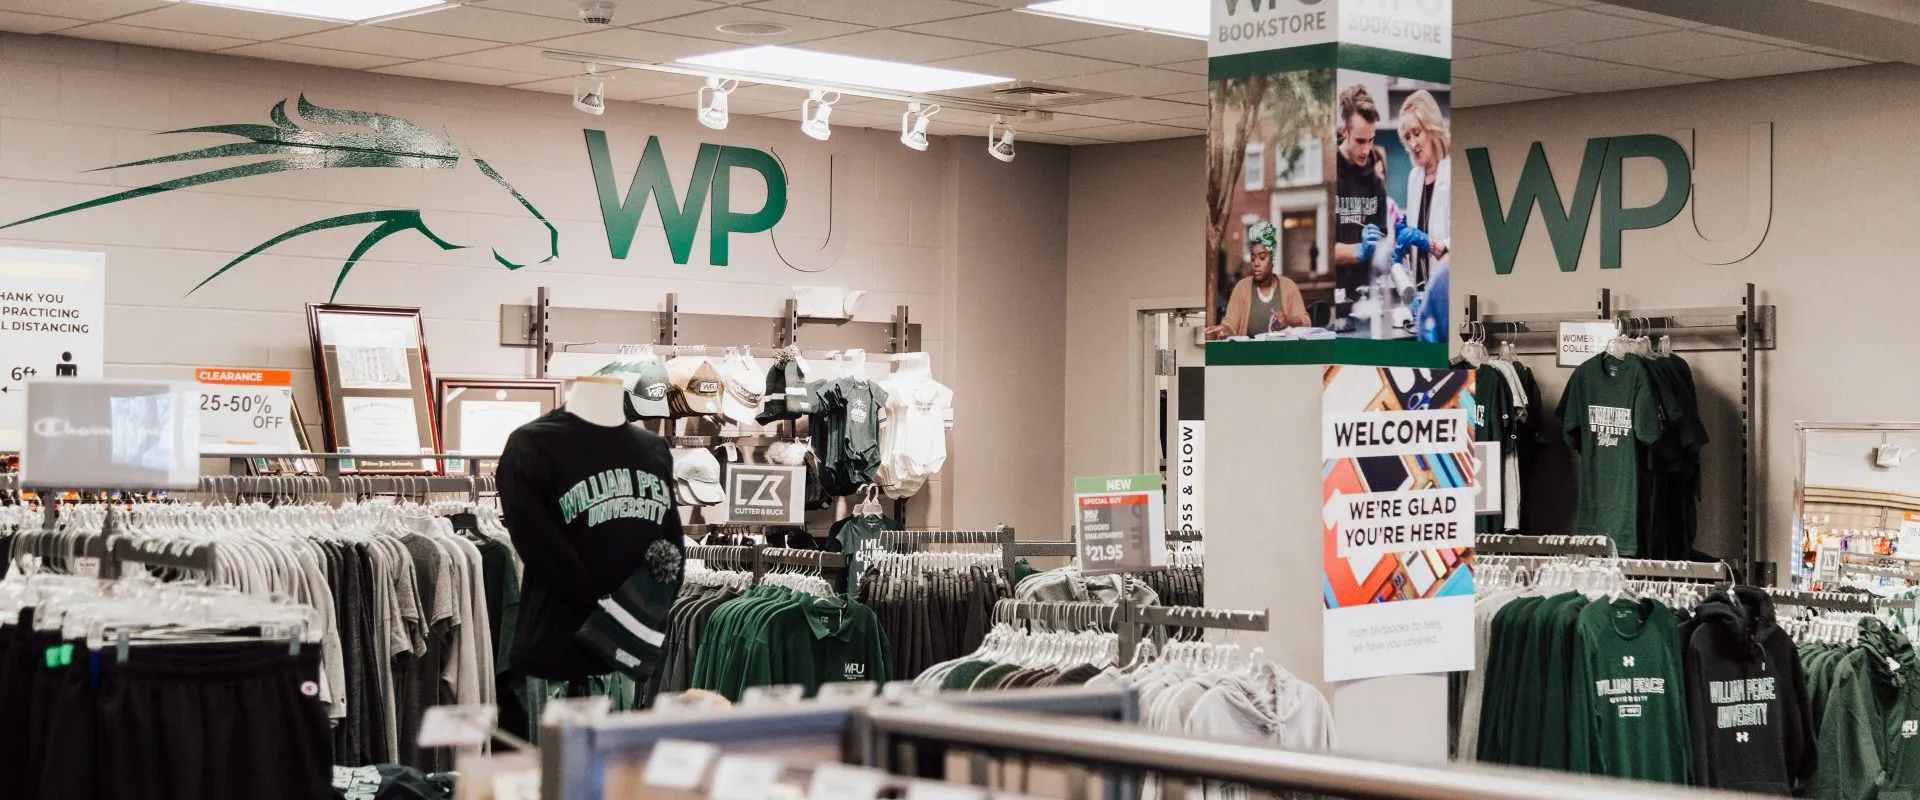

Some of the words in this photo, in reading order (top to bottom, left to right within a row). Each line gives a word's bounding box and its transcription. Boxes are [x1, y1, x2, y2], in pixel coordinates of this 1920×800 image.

[1219, 12, 1326, 43] BOOKSTORE
[1349, 13, 1442, 44] BOOKSTORE
[38, 293, 64, 304] YOU
[2, 306, 80, 319] PRACTICING
[12, 321, 89, 333] DISTANCING
[199, 371, 264, 382] CLEARANCE
[200, 394, 272, 414] 25-50%
[253, 415, 284, 429] OFF
[1334, 418, 1457, 447] WELCOME!
[1182, 426, 1193, 476] GLOW
[1107, 478, 1132, 491] NEW
[1182, 485, 1193, 496] &
[559, 468, 633, 524] WILLIAM
[1083, 497, 1108, 505] SPECIAL
[1109, 496, 1122, 504] BUY
[588, 497, 667, 527] UNIVERSITY
[735, 507, 760, 515] CUTTER
[766, 508, 784, 516] BUCK
[1350, 499, 1402, 520] WE'RE
[1408, 496, 1457, 516] GLAD
[1084, 531, 1124, 541] SWEATSHIRTS
[1345, 525, 1405, 548] YOU'RE
[1410, 522, 1458, 542] HERE
[1085, 543, 1124, 562] $21.95
[844, 662, 865, 674] WPU
[1746, 677, 1776, 700] PEACE
[1717, 703, 1767, 729] UNIVERSITY
